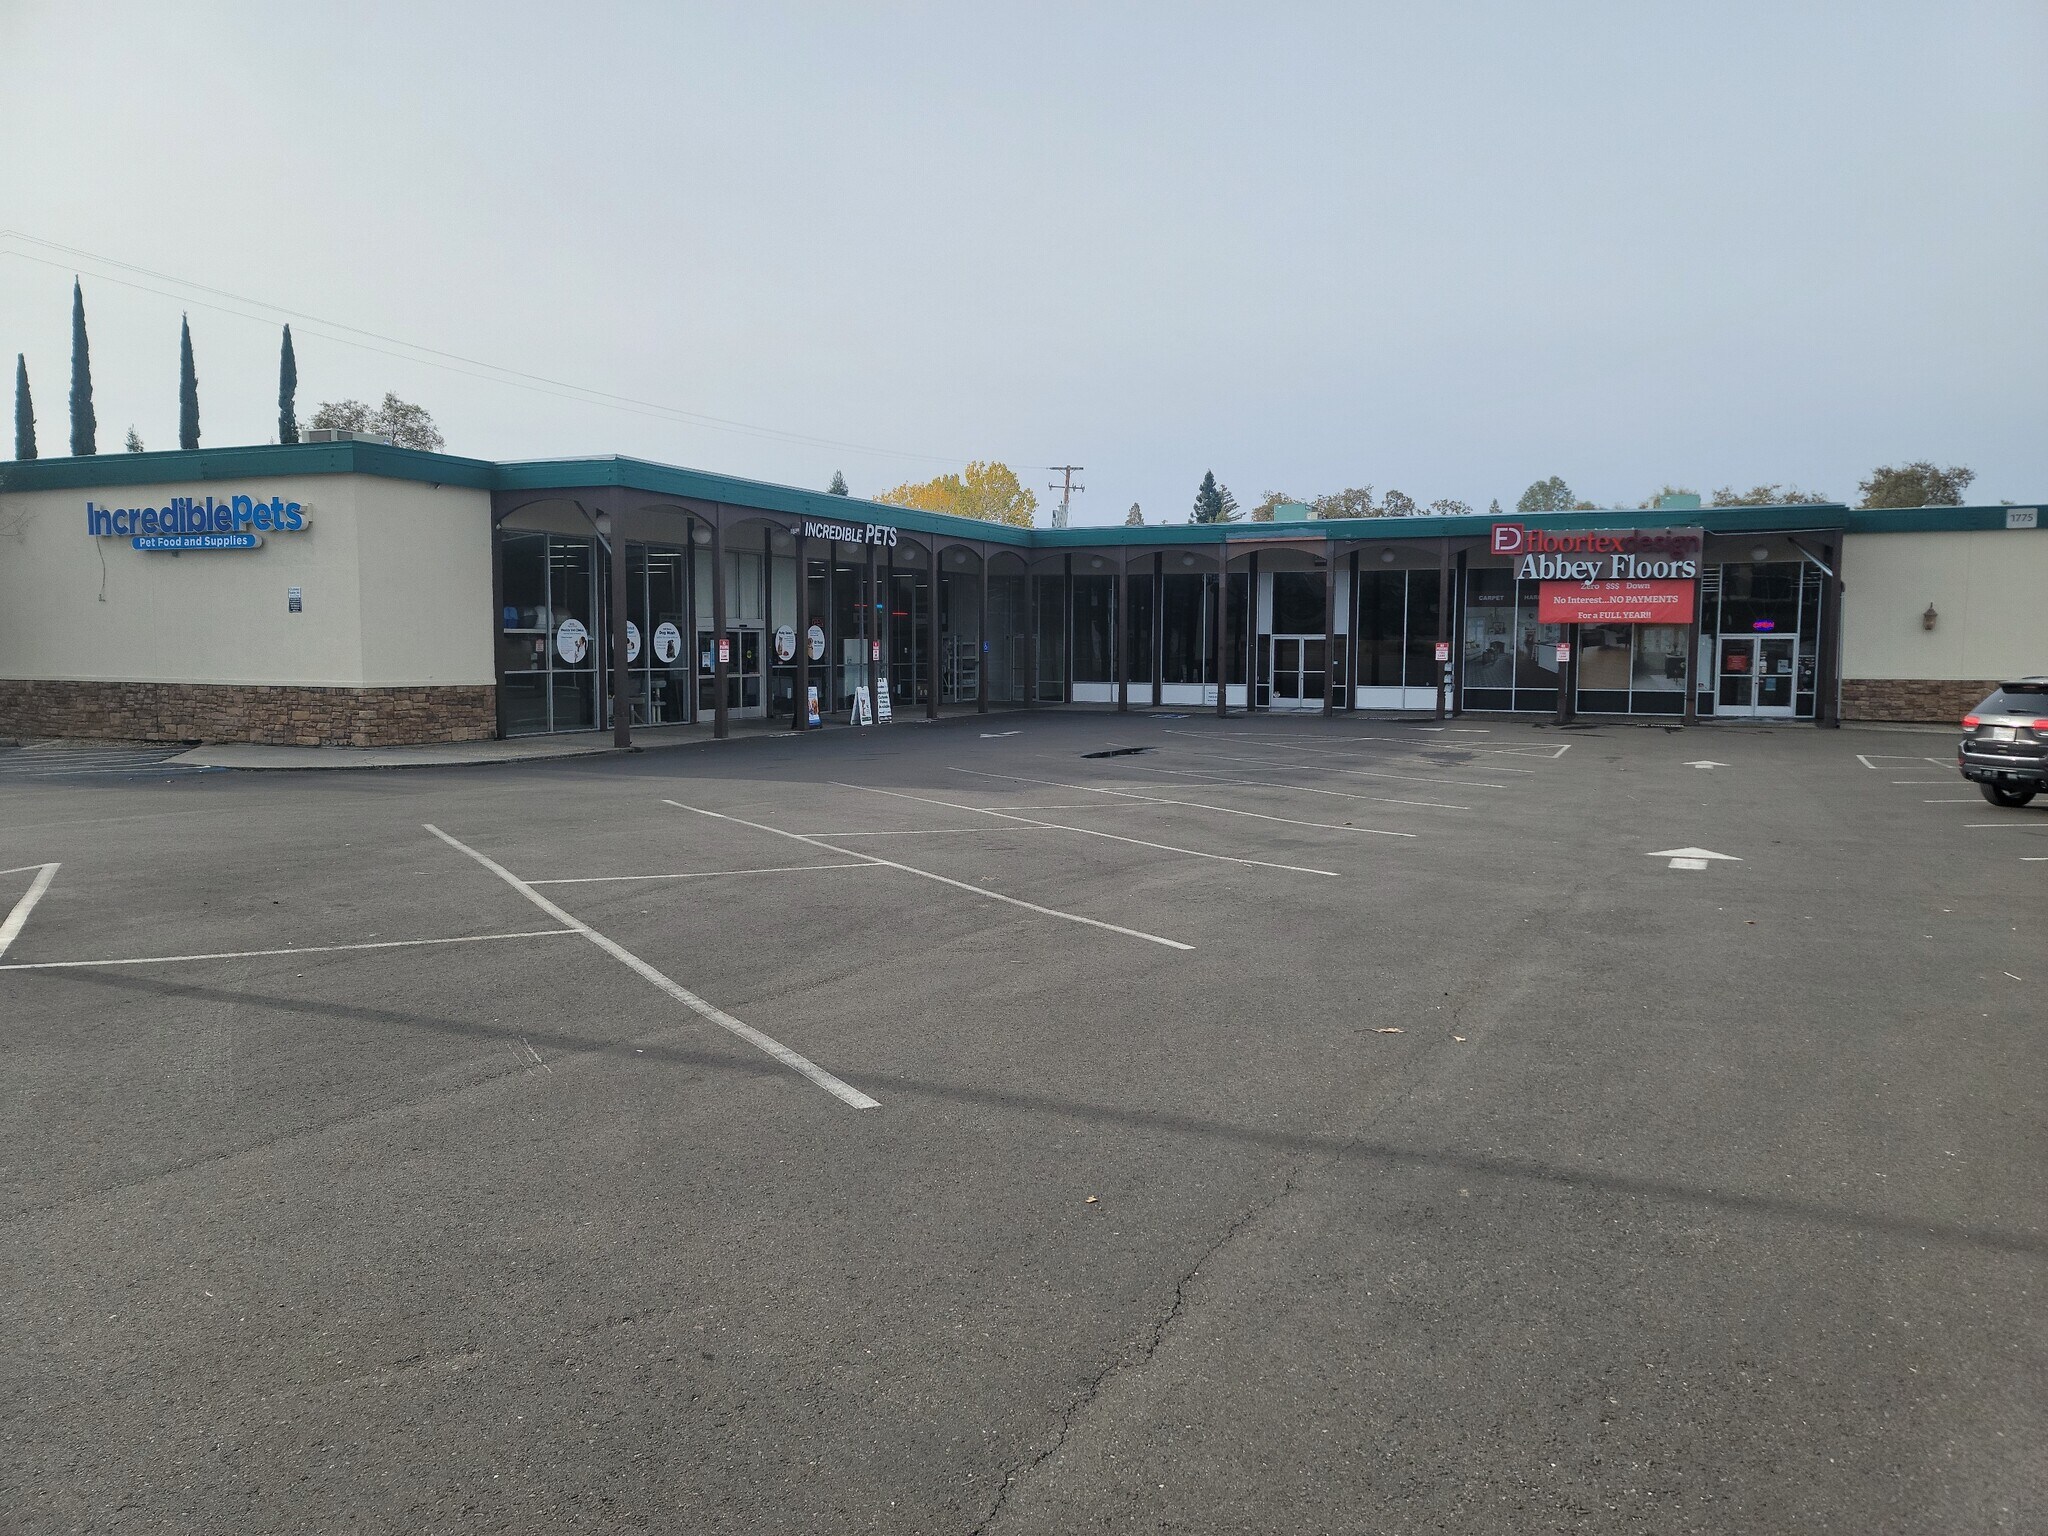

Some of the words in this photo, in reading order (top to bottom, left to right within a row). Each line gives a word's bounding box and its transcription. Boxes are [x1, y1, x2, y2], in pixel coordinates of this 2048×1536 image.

[2010, 513, 2034, 522] 1775
[805, 521, 864, 544] INCREDIBLE
[865, 523, 897, 547] PETS
[139, 537, 156, 547] Pet
[157, 536, 182, 547] Food
[184, 536, 202, 546] and
[204, 535, 248, 547] Supplies
[1526, 529, 1625, 552] floortex
[1517, 553, 1603, 585] Abbey
[1609, 553, 1696, 580] Floors
[1580, 582, 1600, 590] Zero
[1626, 582, 1651, 590] Down
[1553, 596, 1567, 604] No
[1625, 595, 1679, 604] PAYMENTS
[1577, 611, 1592, 619] For
[1599, 611, 1622, 619] FULL
